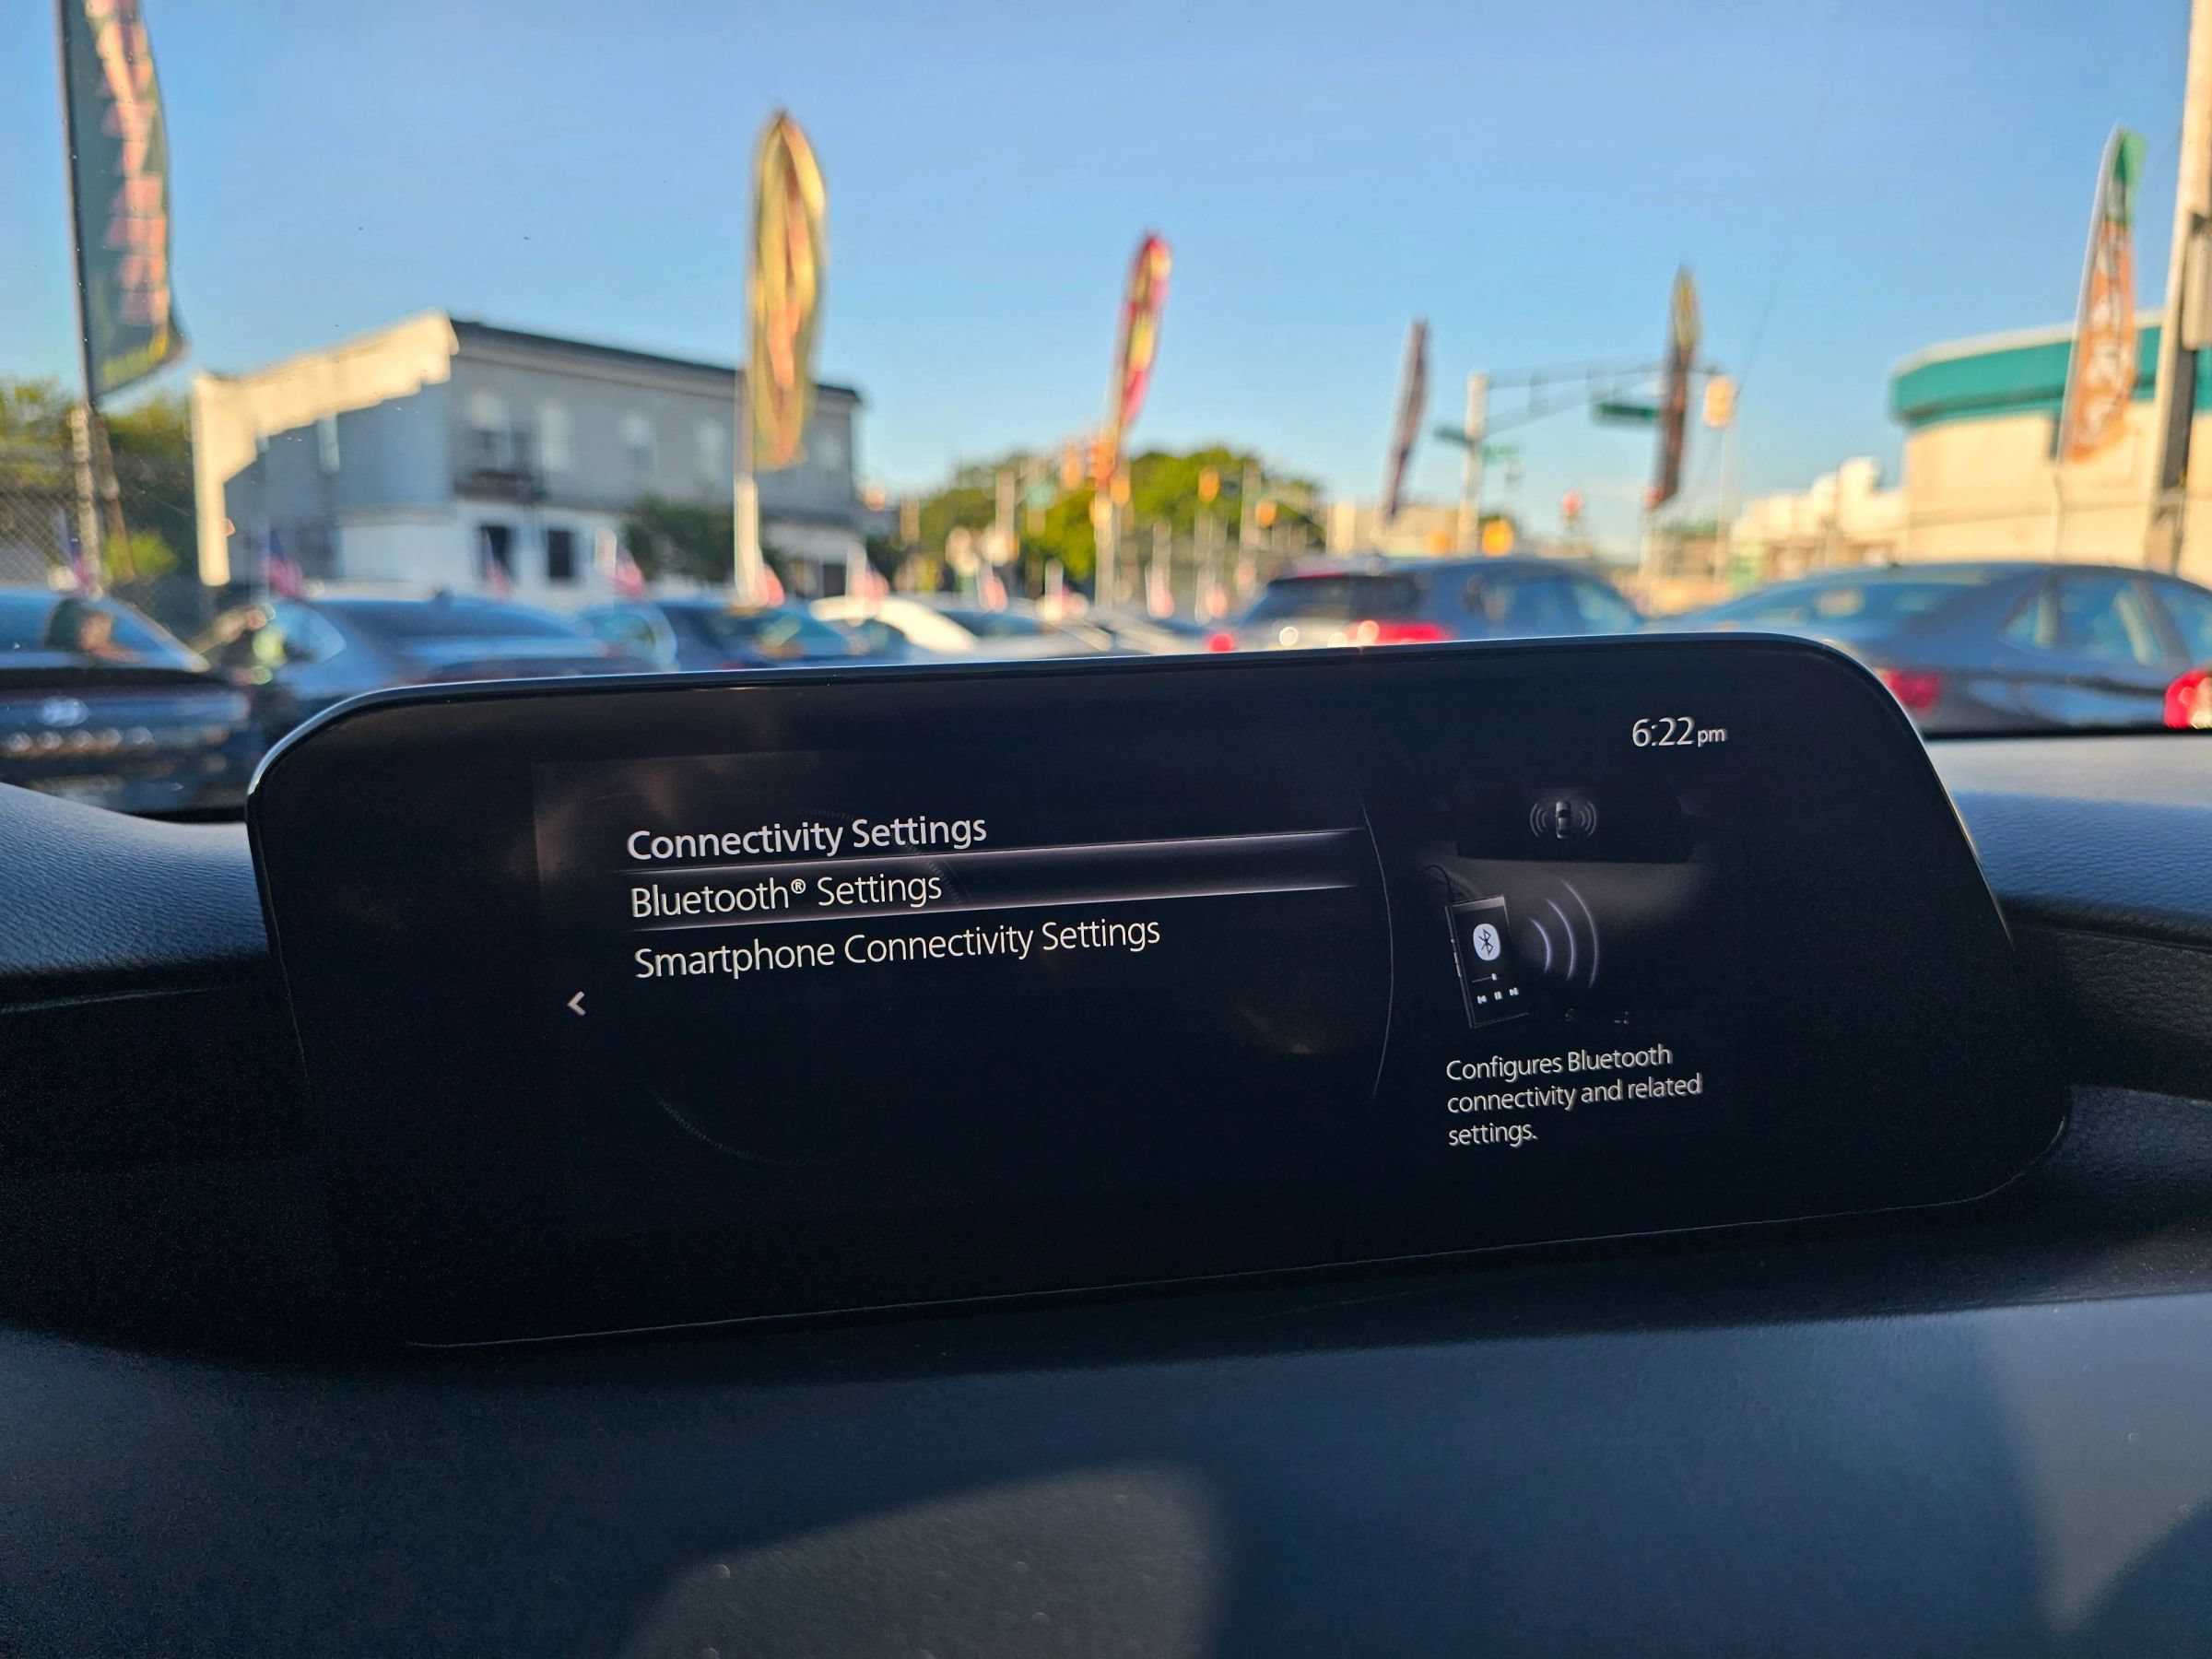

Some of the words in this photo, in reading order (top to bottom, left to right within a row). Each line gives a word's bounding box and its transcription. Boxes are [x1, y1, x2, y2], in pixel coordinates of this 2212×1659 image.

[628, 821, 843, 860] Connectivity
[852, 816, 987, 849] Settings
[817, 873, 942, 906] Settings
[635, 938, 835, 980] Smartphone
[844, 924, 1034, 964] Connectivity
[1041, 918, 1160, 952] Settings
[1446, 1055, 1563, 1083] Configures
[1568, 1043, 1671, 1072] Bluetooth
[1447, 1085, 1576, 1113] connectivity
[1581, 1078, 1622, 1103] and
[1628, 1072, 1700, 1099] related
[1449, 1122, 1537, 1147] settings.
